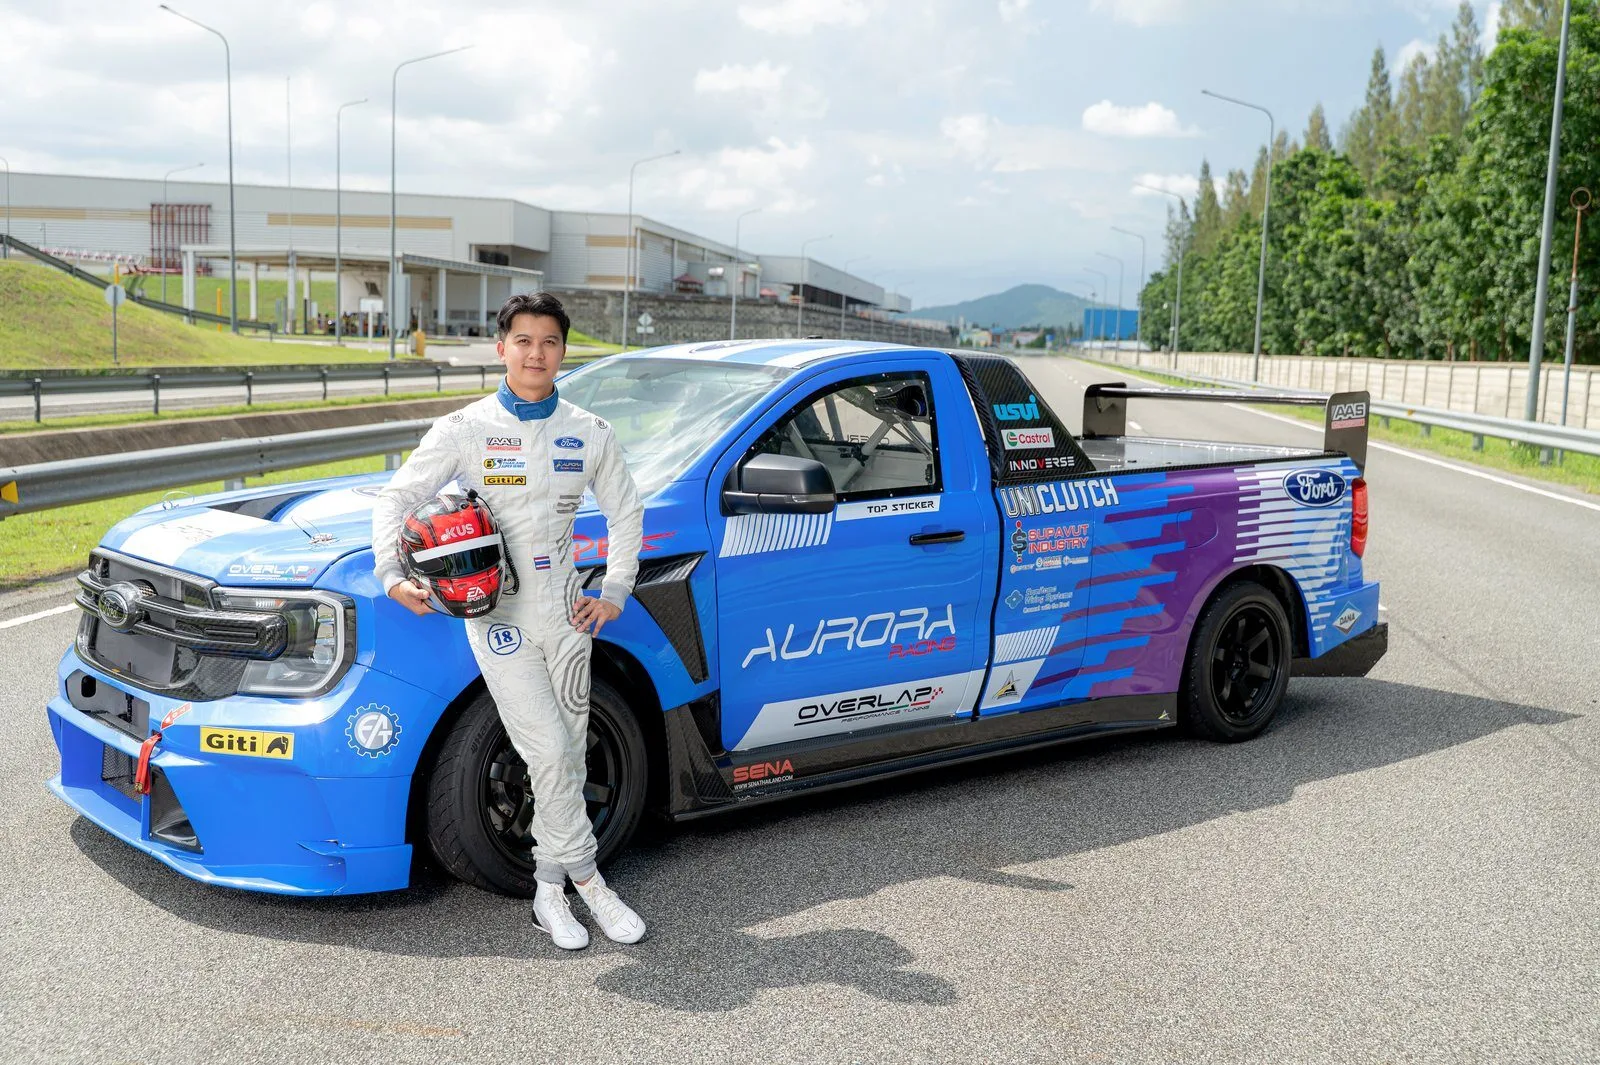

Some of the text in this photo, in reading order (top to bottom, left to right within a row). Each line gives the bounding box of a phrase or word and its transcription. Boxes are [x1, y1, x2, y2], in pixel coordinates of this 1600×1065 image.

[1332, 402, 1366, 420] AAS
[487, 437, 521, 446] AAS
[1018, 433, 1050, 444] Castrol
[1009, 456, 1075, 471] INNOVERSE
[1296, 472, 1338, 501] Ford
[1000, 478, 1119, 518] UNICLUTCH
[867, 501, 935, 513] TOP STICKER
[1028, 523, 1089, 541] SUPAVUT
[1028, 537, 1089, 554] INDUSTRY
[229, 564, 309, 575] OVERLAP
[467, 586, 486, 597] EA
[467, 594, 487, 602] SPORTS
[1340, 612, 1356, 625] DANA
[494, 630, 513, 646] 18
[741, 603, 956, 669] AURORA
[888, 636, 956, 660] RACING
[798, 686, 933, 719] OVERLAP
[841, 705, 930, 723] PERFORMANCE TUNING
[206, 733, 257, 752] Giti
[733, 759, 794, 783] SENA
[734, 775, 794, 790] WWW.SENATHAILAND.COM
